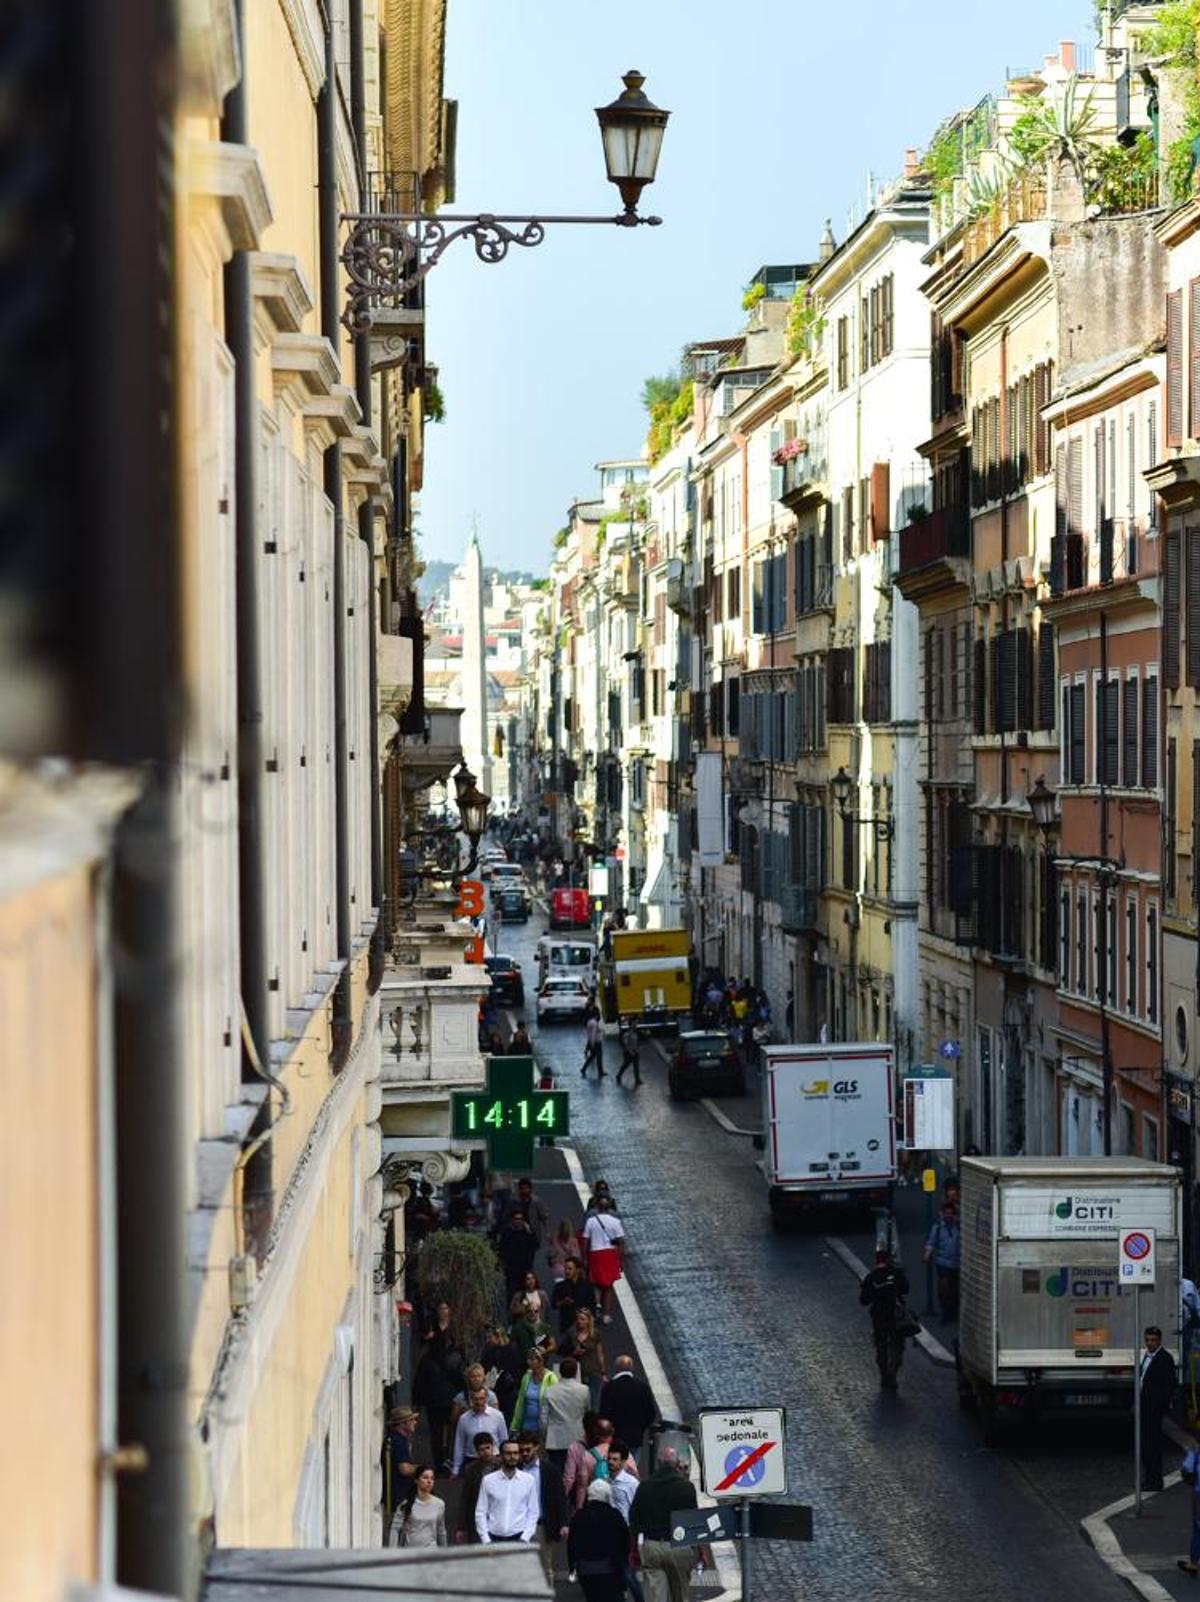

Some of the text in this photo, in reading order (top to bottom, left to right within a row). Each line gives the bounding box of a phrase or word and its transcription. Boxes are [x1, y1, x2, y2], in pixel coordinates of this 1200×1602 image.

[833, 1081, 858, 1094] GLS
[465, 1099, 556, 1129] 14:14
[1075, 1206, 1113, 1219] CITI
[1073, 1280, 1122, 1297] CITI
